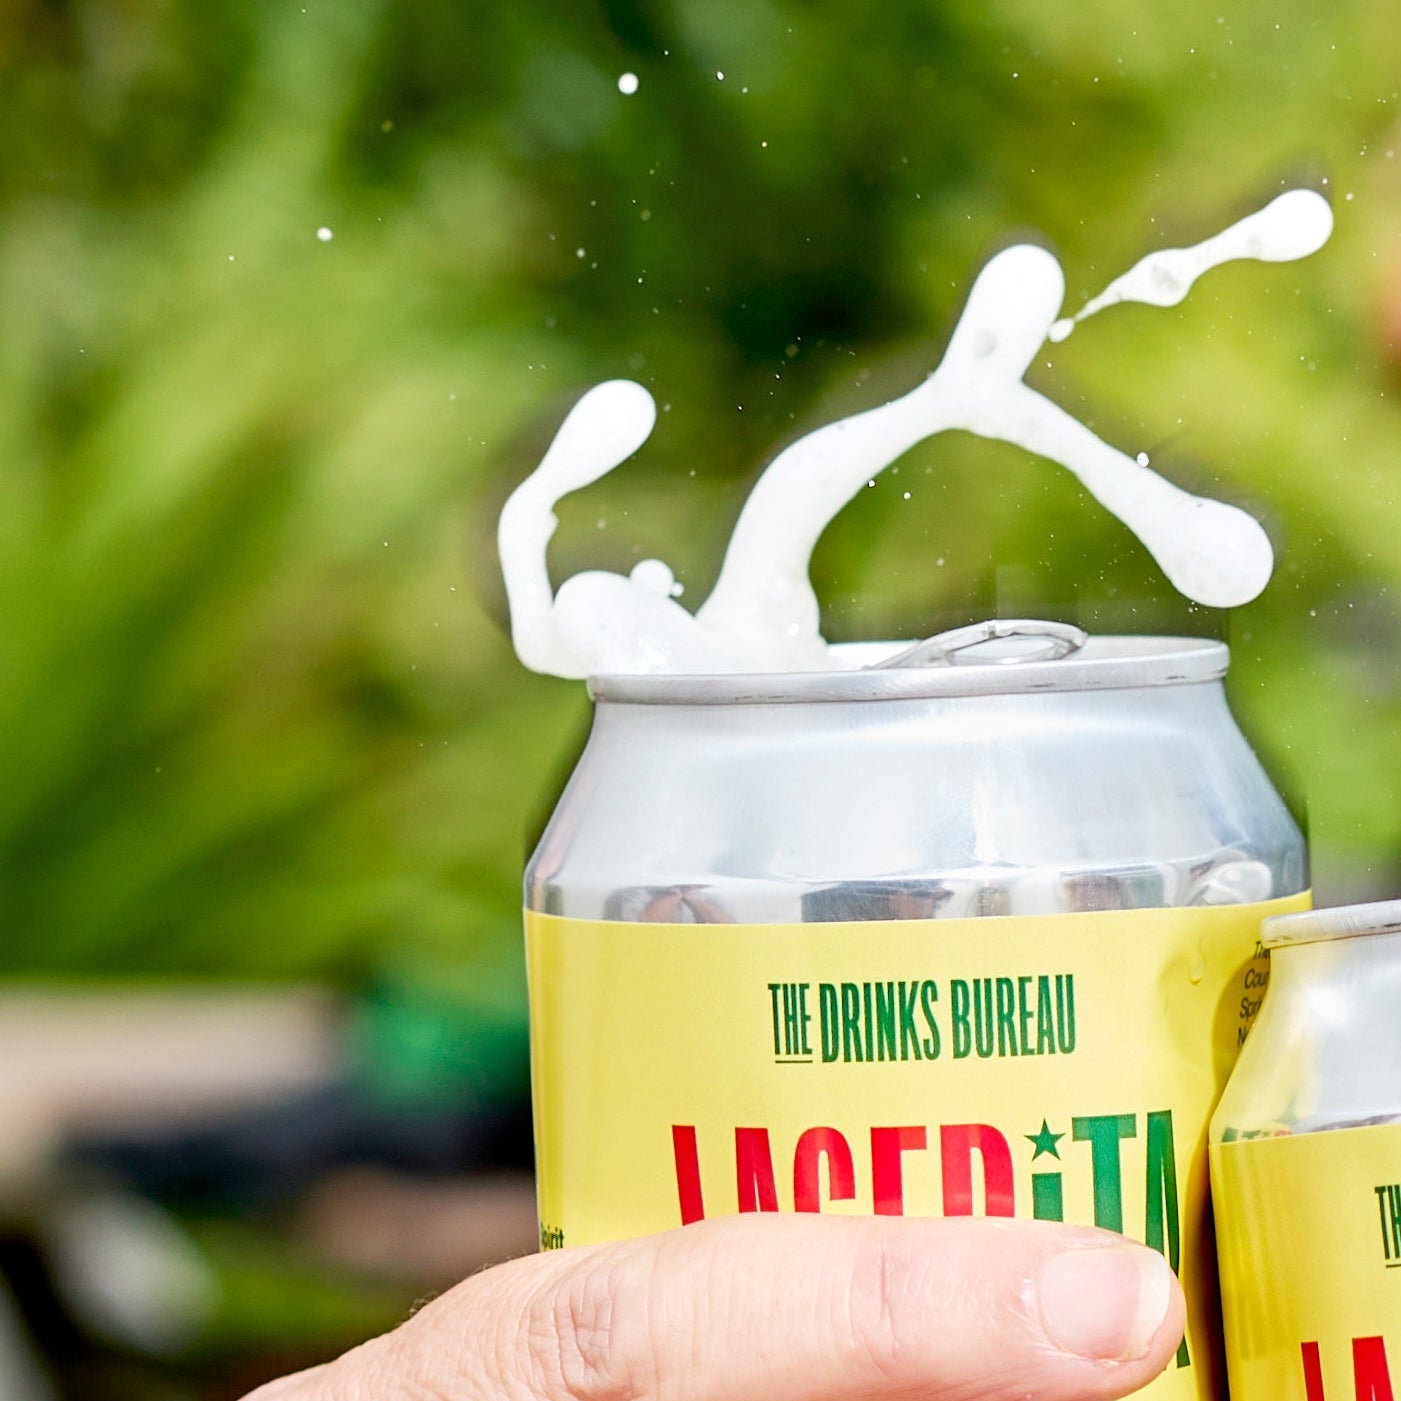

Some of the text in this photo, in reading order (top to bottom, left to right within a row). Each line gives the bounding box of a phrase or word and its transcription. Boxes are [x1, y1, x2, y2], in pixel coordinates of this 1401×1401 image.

[768, 974, 1076, 1063] THE DRINKS BUREAU
